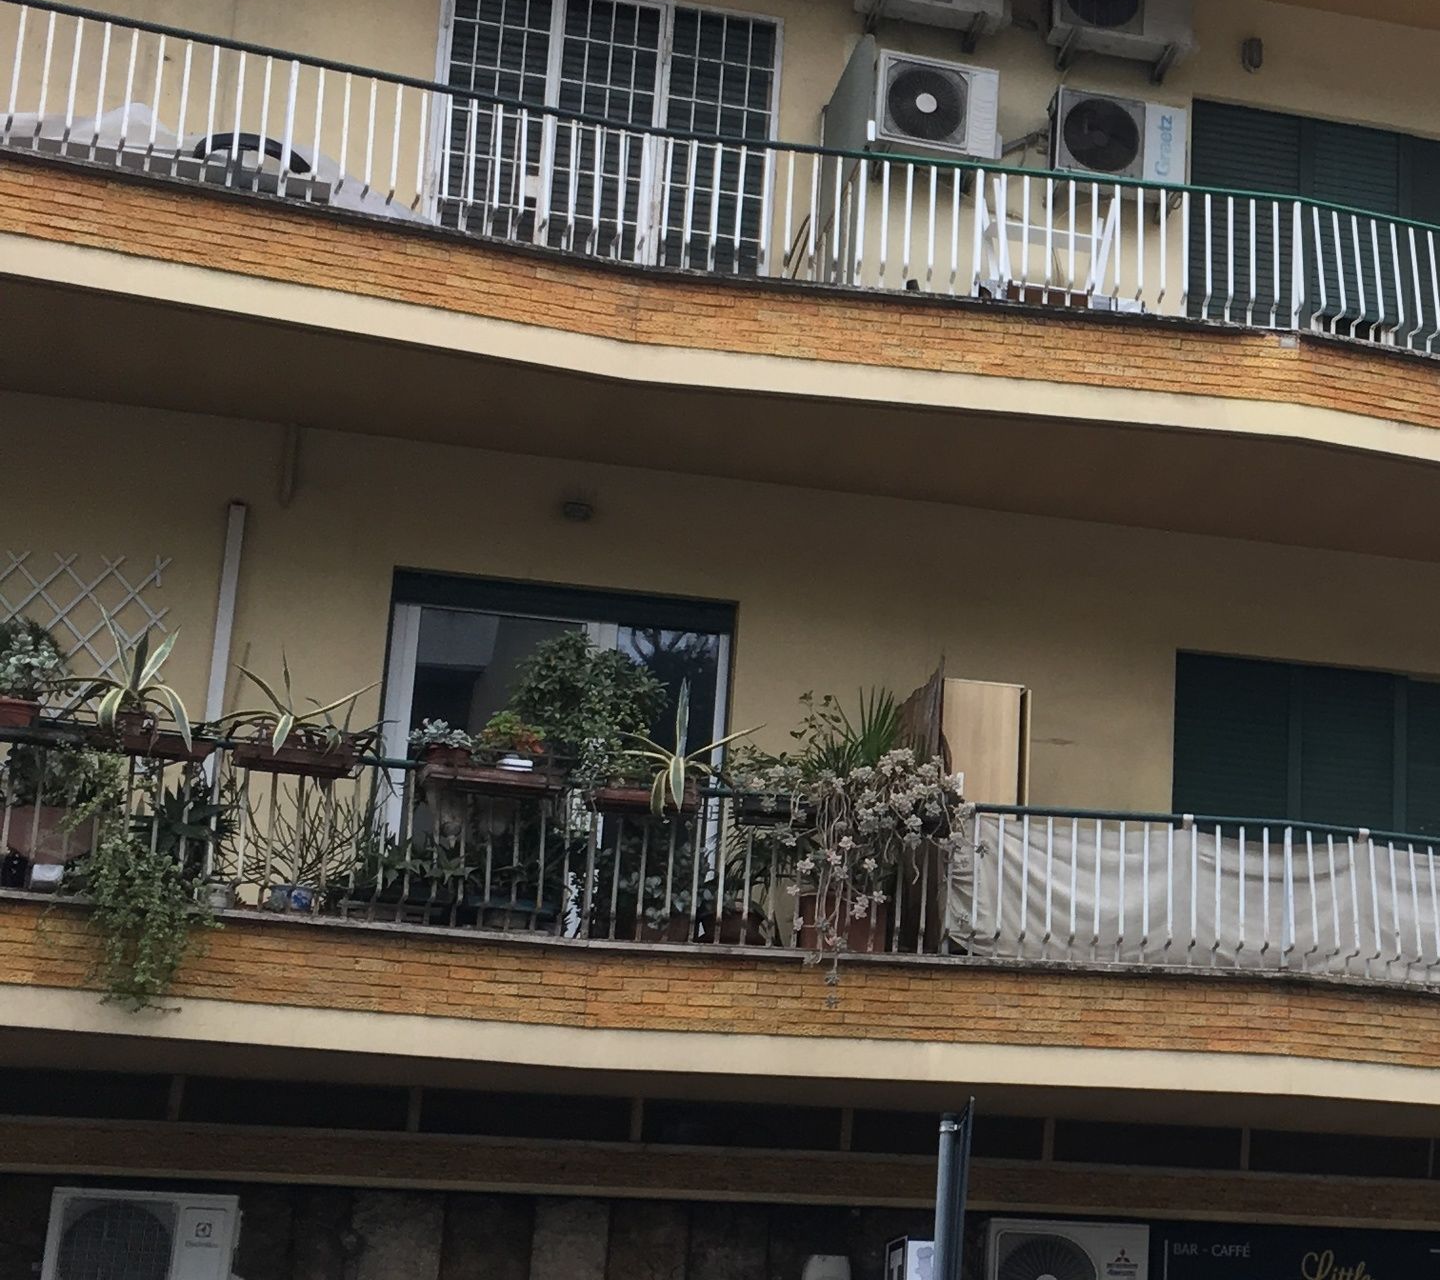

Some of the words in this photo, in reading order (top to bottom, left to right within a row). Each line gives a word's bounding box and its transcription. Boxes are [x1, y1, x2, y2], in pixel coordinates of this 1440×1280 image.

[1154, 114, 1173, 177] Graetz
[1172, 1242, 1199, 1255] BAR
[1210, 1241, 1251, 1258] CAFFÉ
